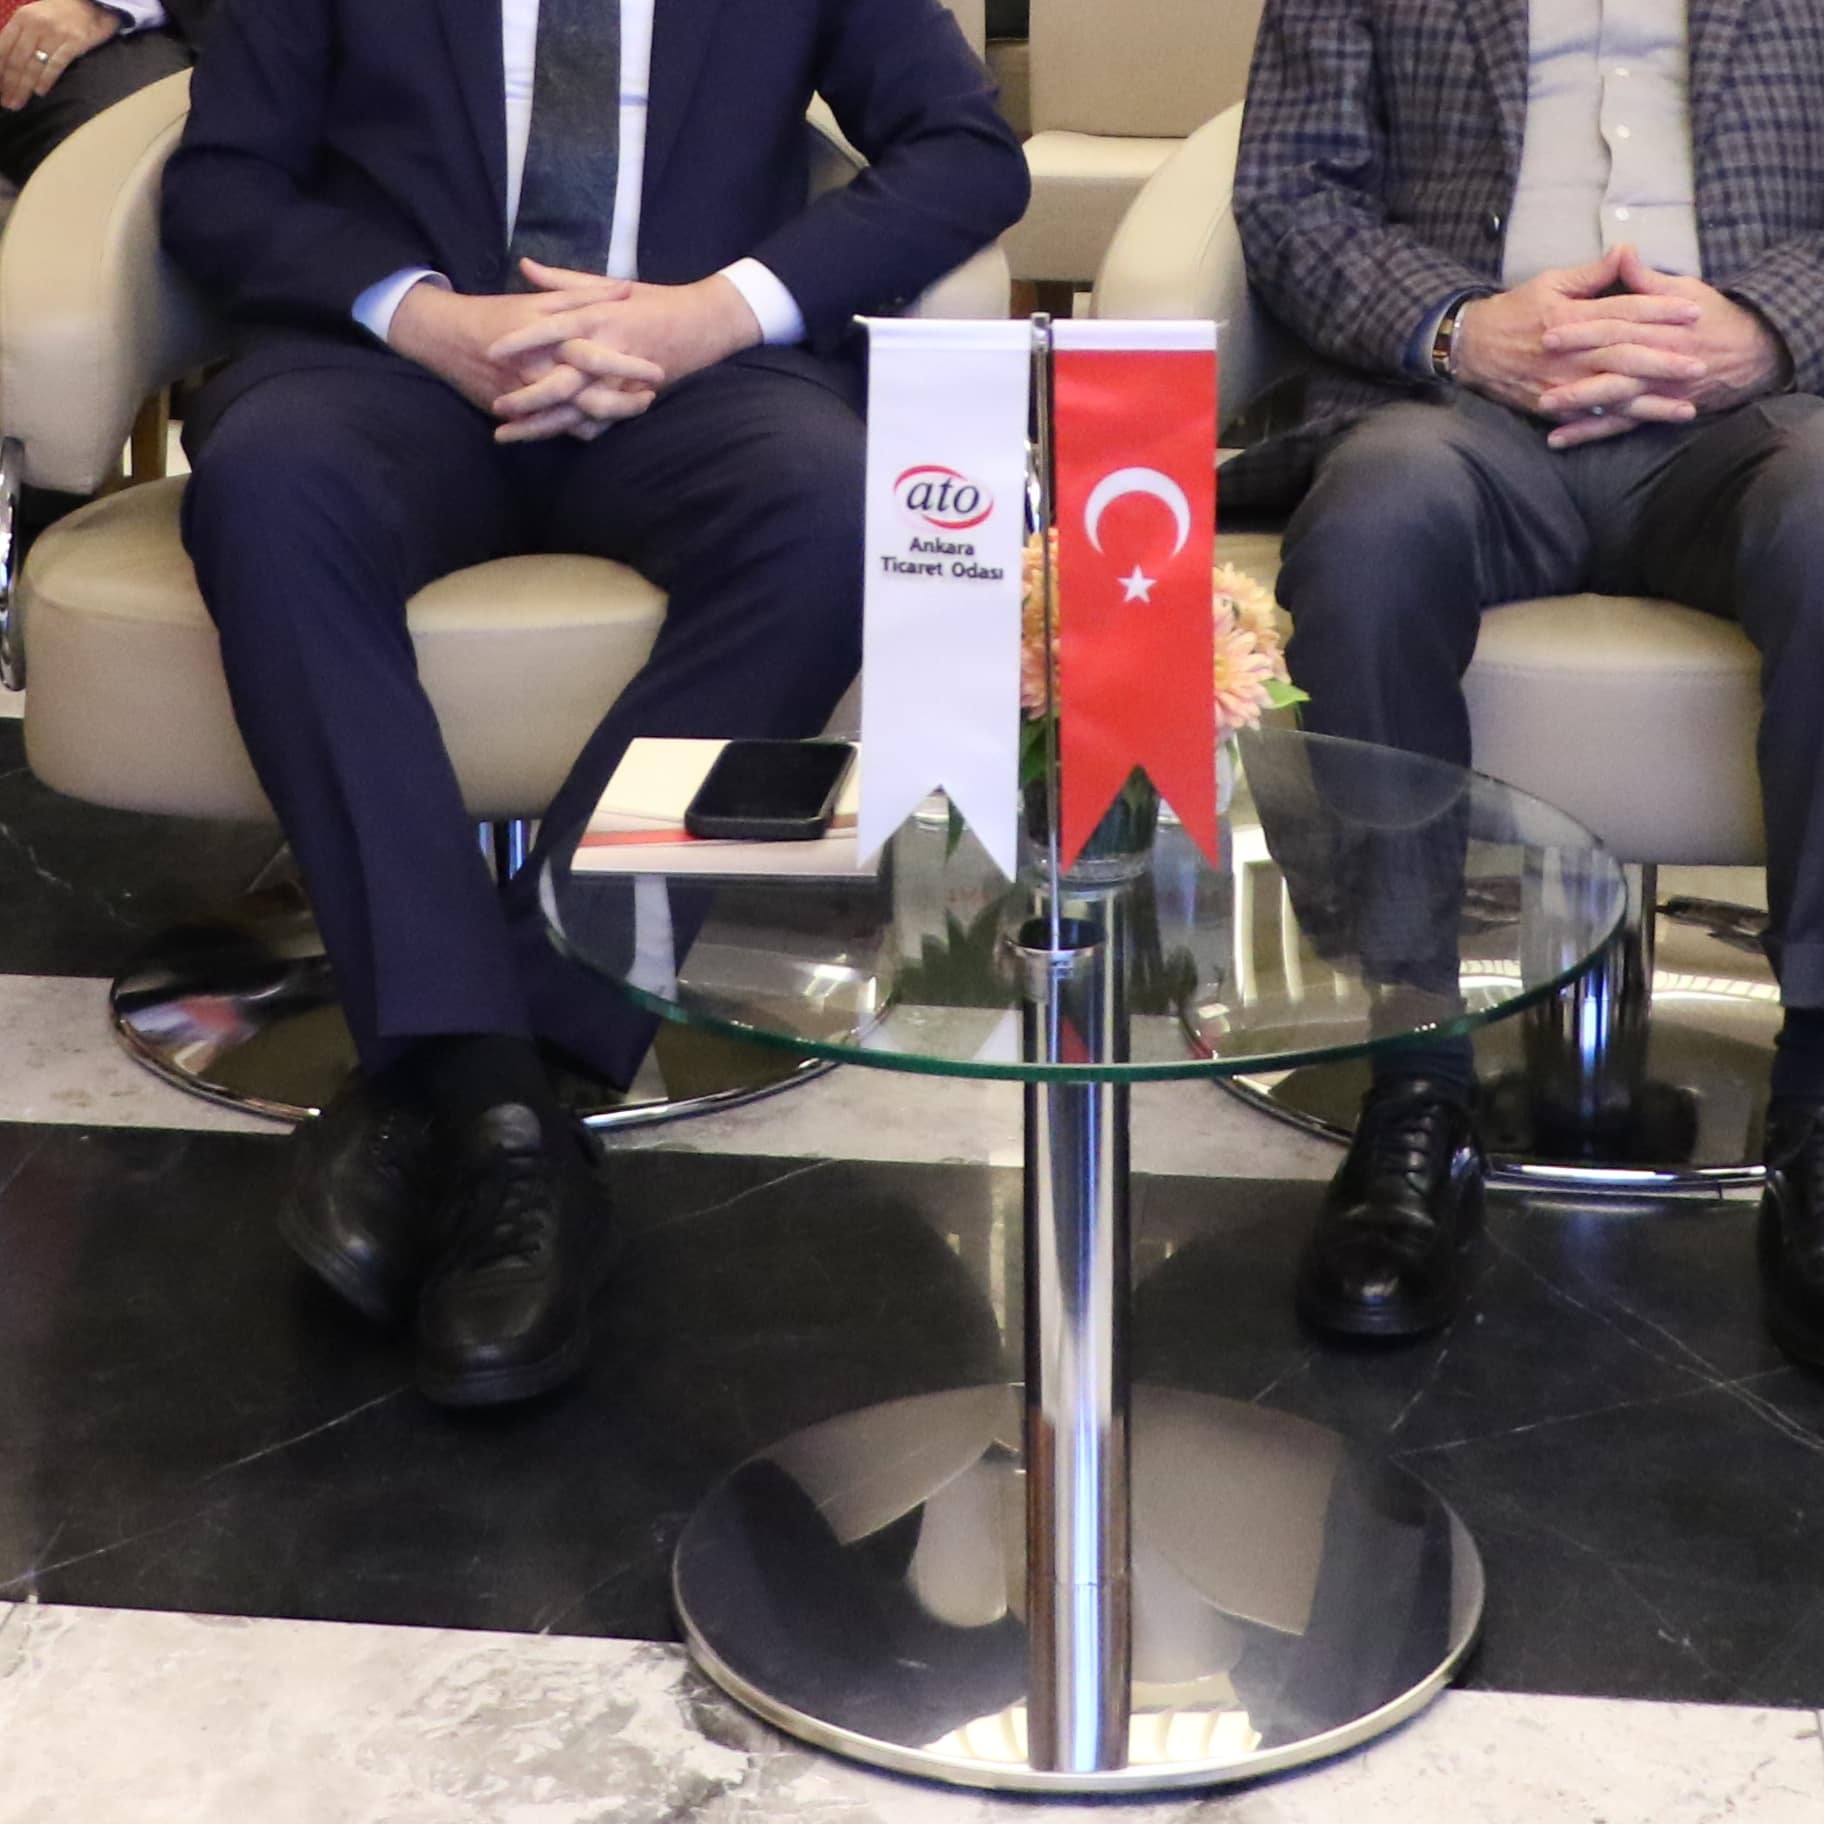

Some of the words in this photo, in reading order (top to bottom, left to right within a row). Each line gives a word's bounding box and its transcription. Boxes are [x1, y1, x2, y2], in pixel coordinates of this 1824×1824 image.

[906, 477, 980, 514] ato
[909, 537, 975, 556] Ankara
[880, 556, 944, 576] Ticaret
[951, 561, 1004, 580] Odası
